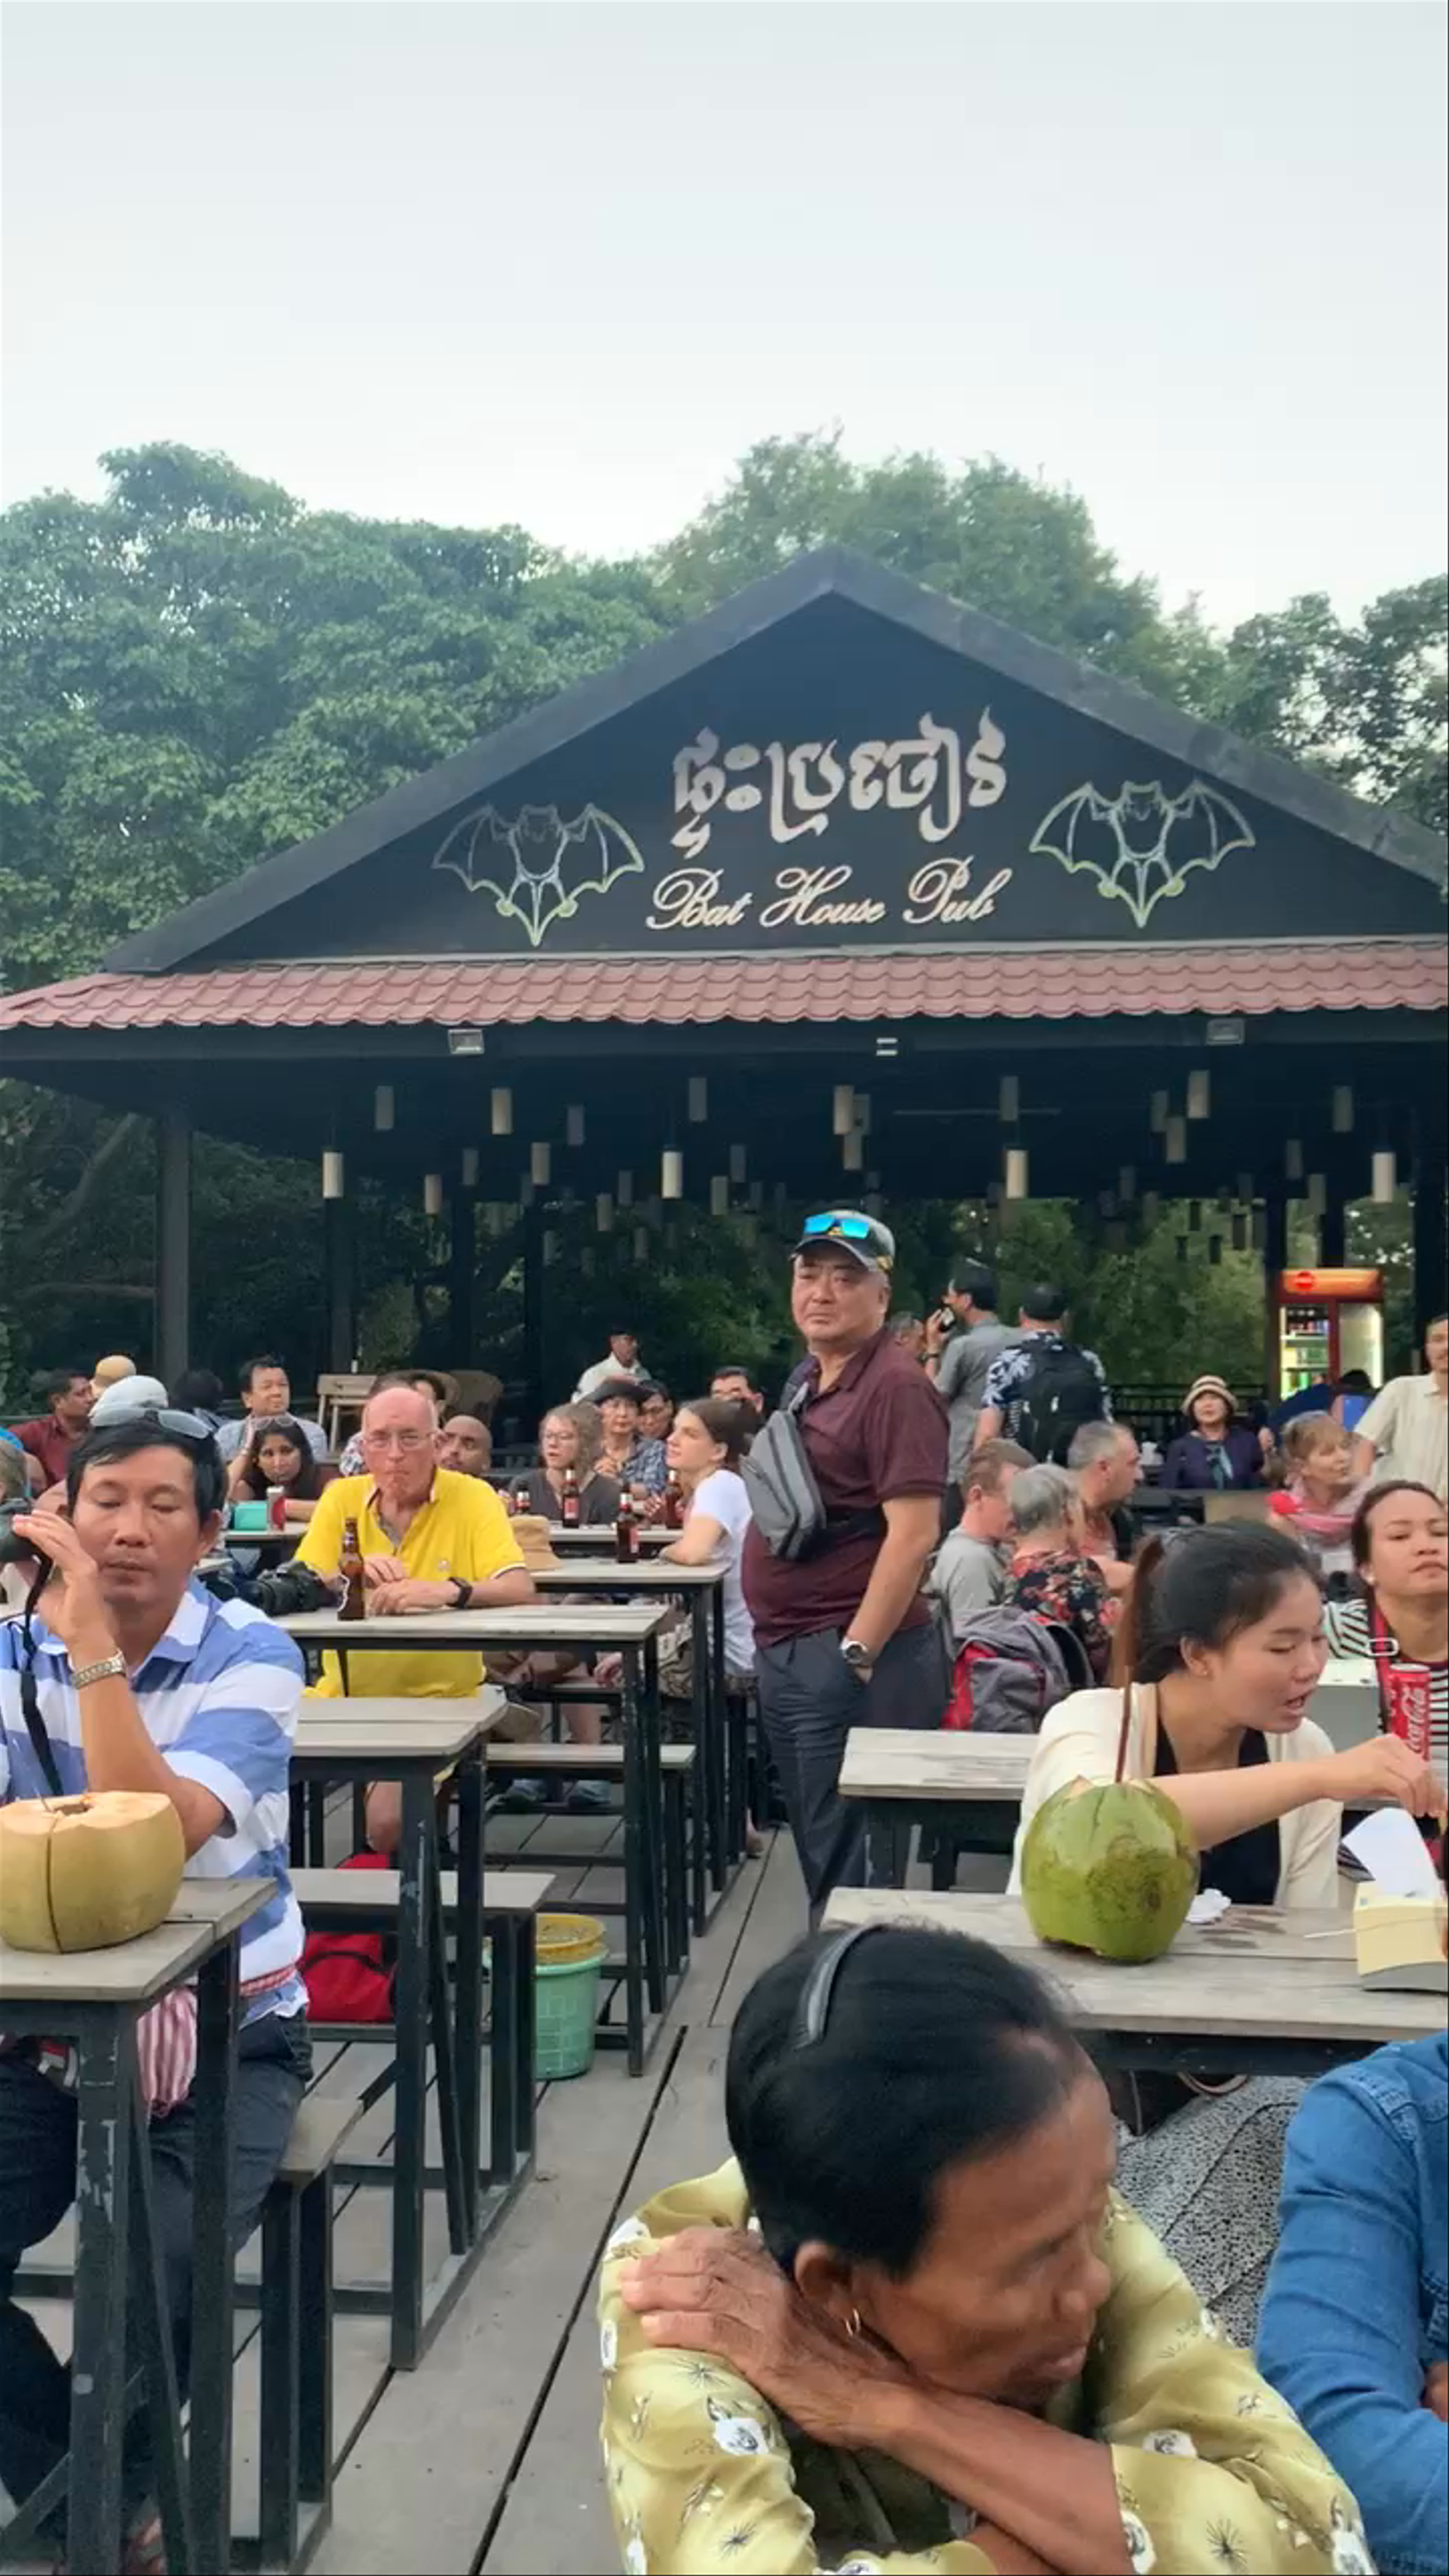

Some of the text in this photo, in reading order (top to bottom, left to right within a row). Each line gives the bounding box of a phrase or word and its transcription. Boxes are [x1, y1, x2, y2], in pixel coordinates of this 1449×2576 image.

[645, 855, 1012, 930] Bat House Pub
